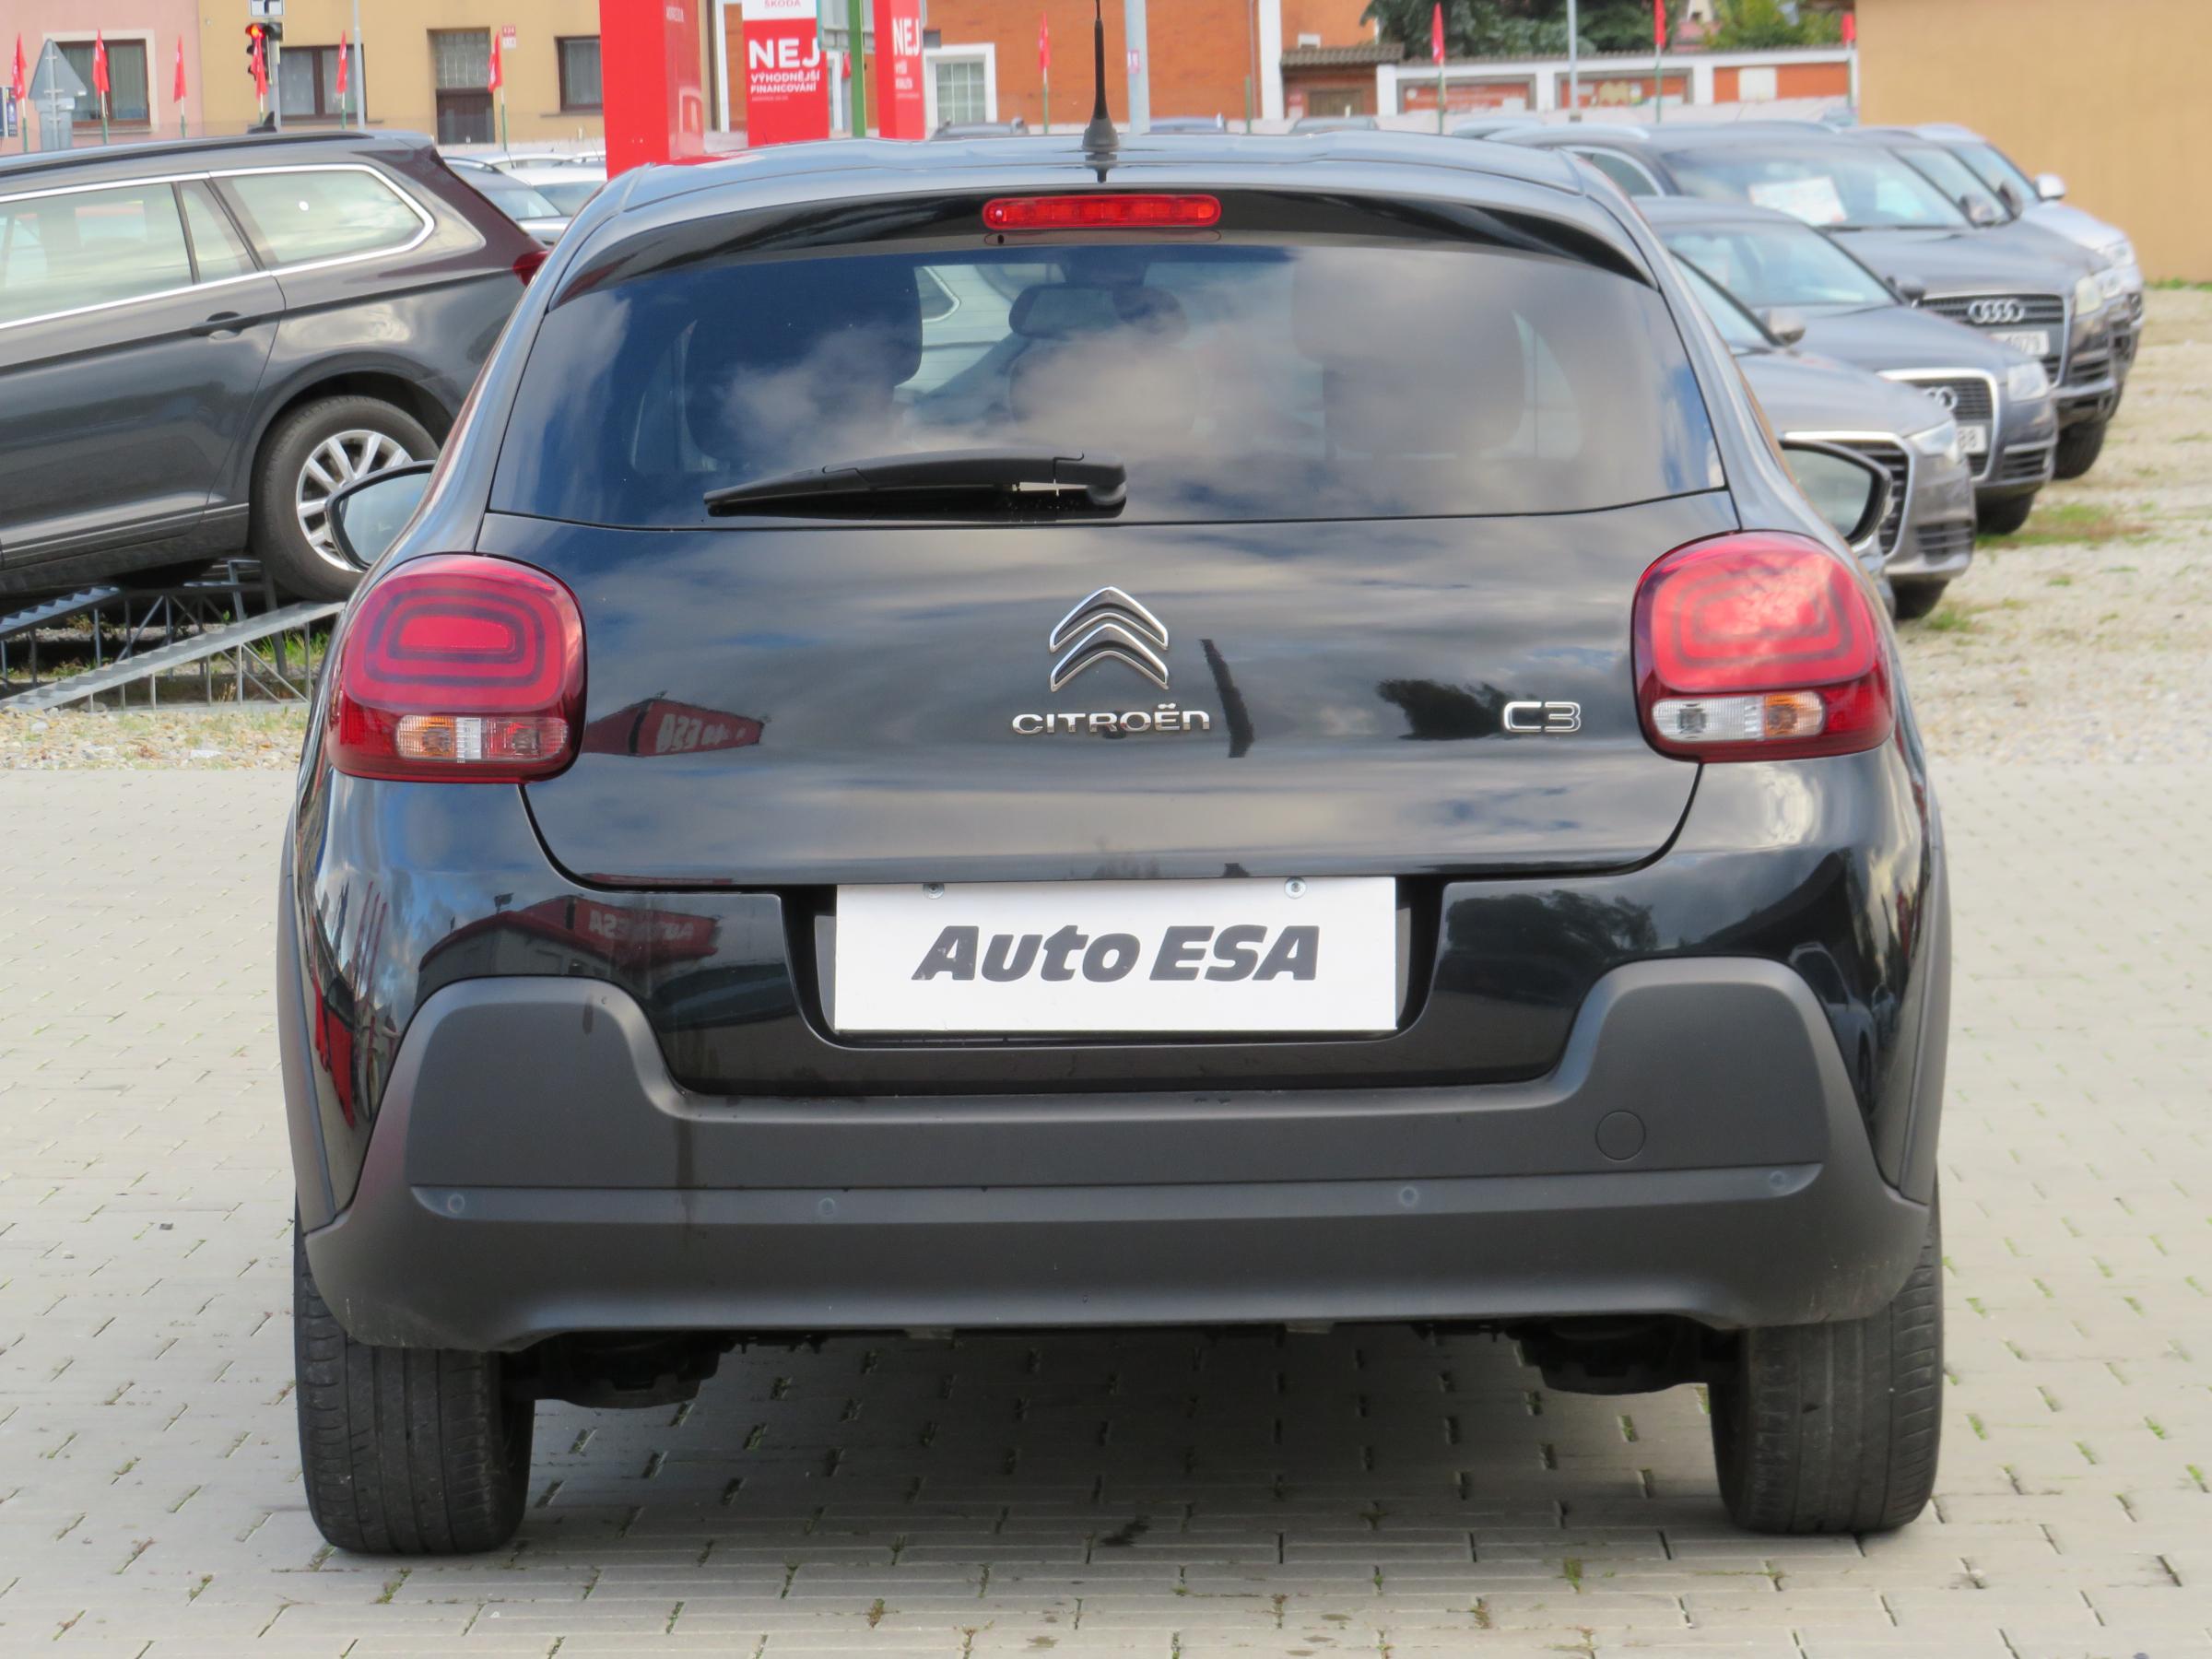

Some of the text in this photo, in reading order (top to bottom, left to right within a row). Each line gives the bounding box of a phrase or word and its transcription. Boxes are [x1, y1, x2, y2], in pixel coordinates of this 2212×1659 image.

[748, 38, 820, 70] NEJ
[891, 18, 920, 56] NEJ
[1503, 701, 1582, 733] C3
[911, 924, 1320, 982] Auto ESA
